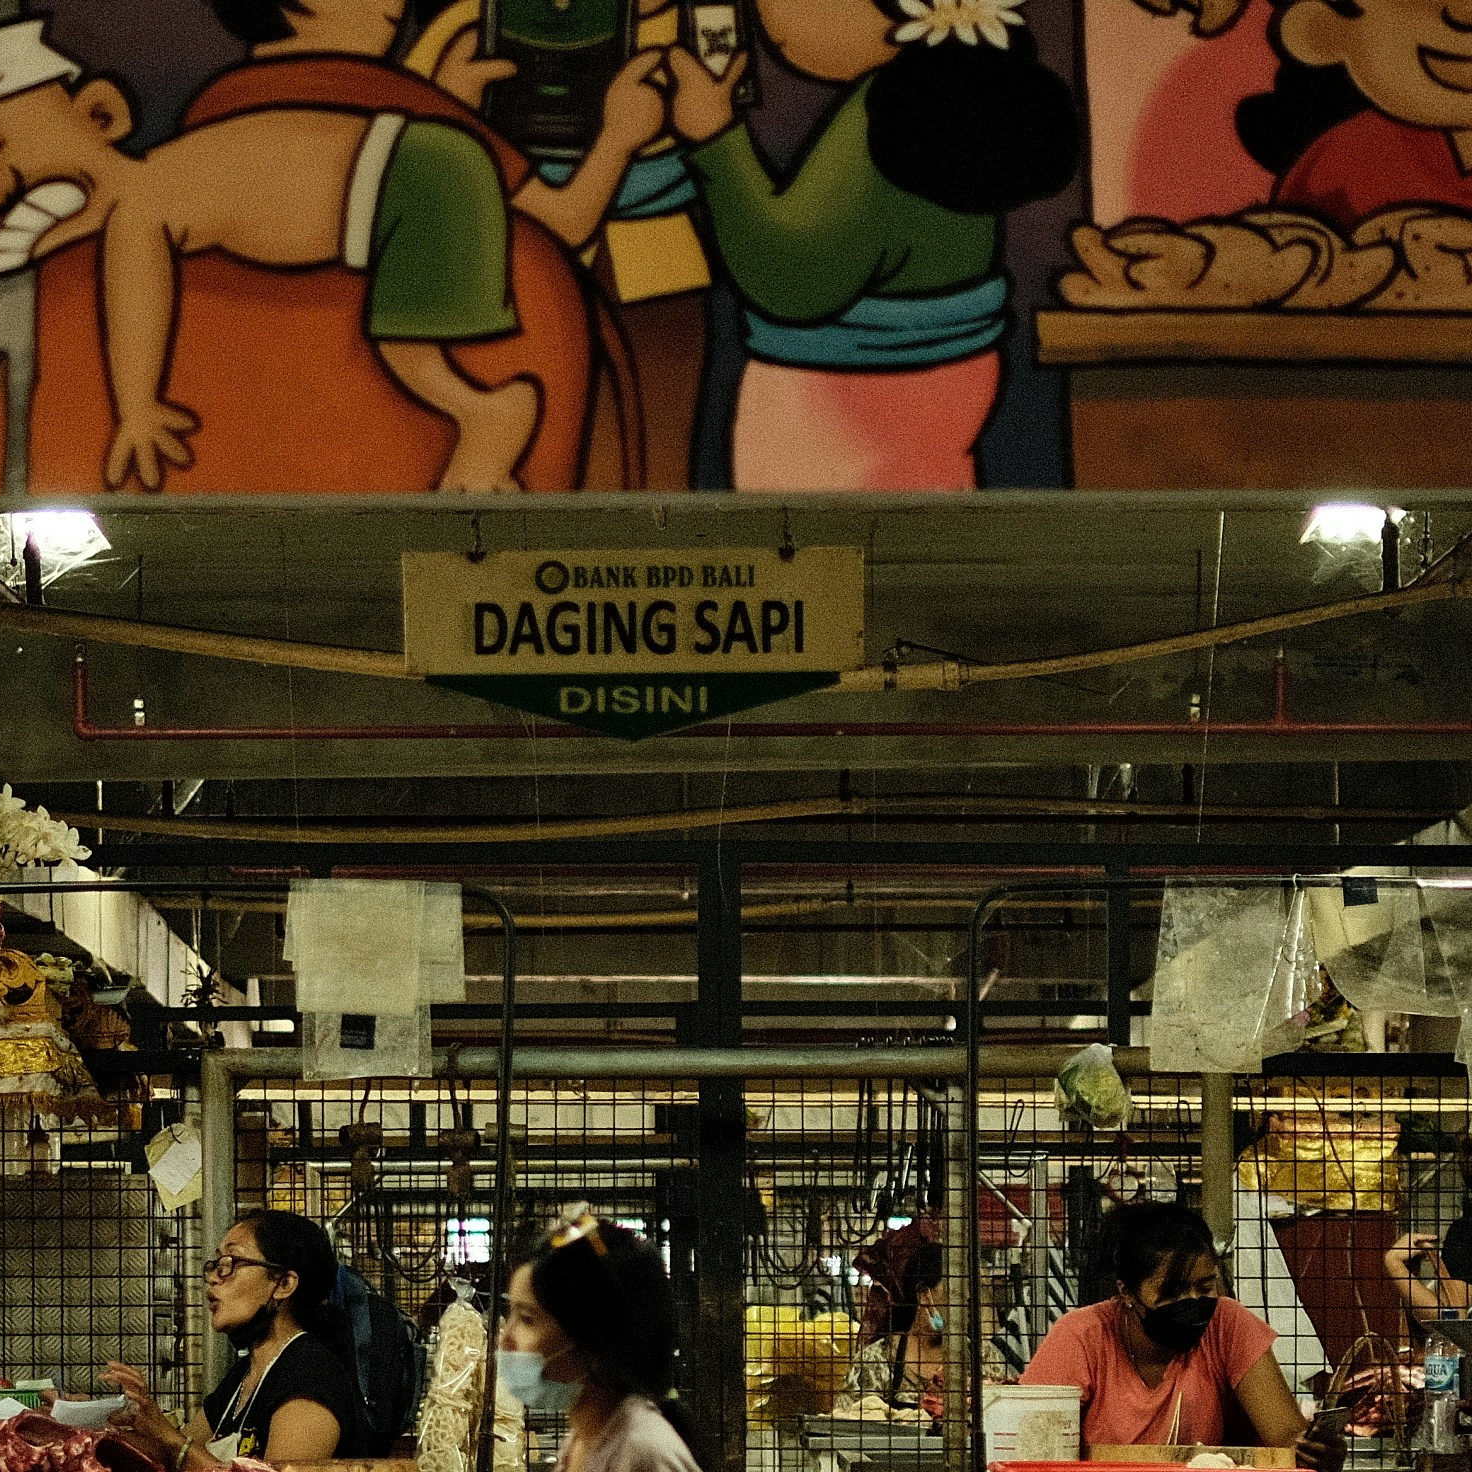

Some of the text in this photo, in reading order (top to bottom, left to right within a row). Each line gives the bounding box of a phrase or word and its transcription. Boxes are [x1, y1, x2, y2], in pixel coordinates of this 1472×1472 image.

[573, 563, 756, 588] BANK BPD BALI
[473, 599, 805, 656] DAGING SAPI
[559, 685, 709, 714] DISINI
